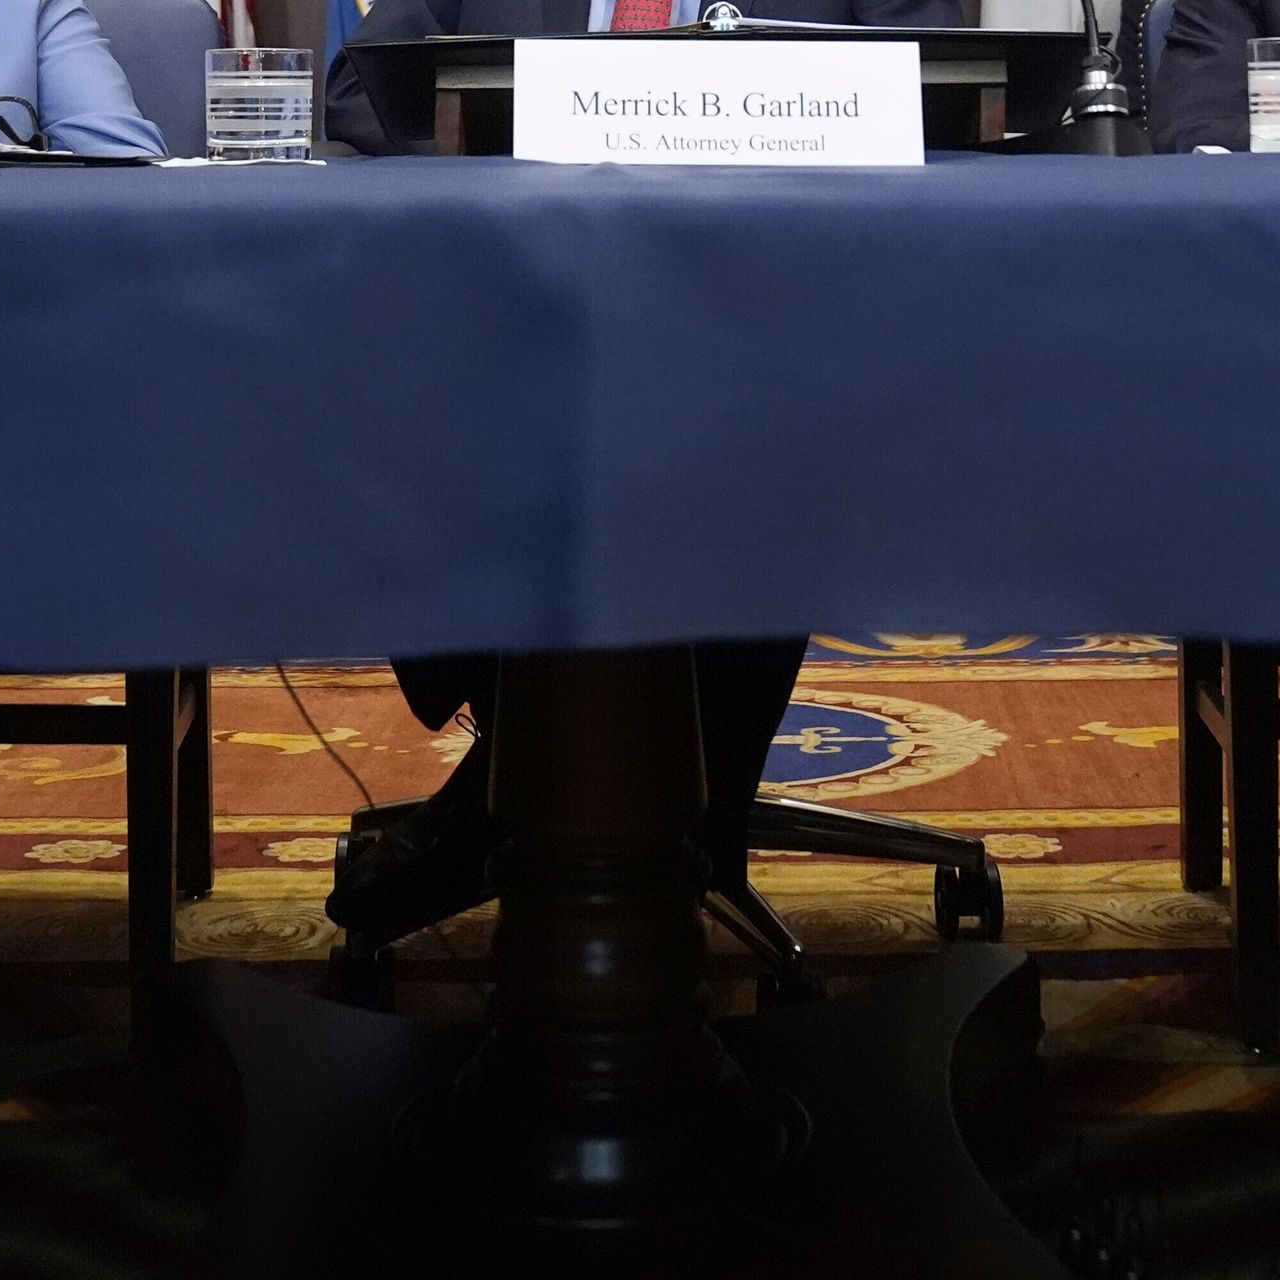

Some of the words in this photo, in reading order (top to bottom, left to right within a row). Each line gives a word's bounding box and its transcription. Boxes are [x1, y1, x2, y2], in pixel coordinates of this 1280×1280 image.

[571, 90, 688, 117] Merrick
[700, 92, 731, 117] B.
[743, 92, 860, 118] Garland
[604, 133, 648, 152] U.S.
[656, 134, 742, 155] Attorney
[748, 134, 826, 152] General
